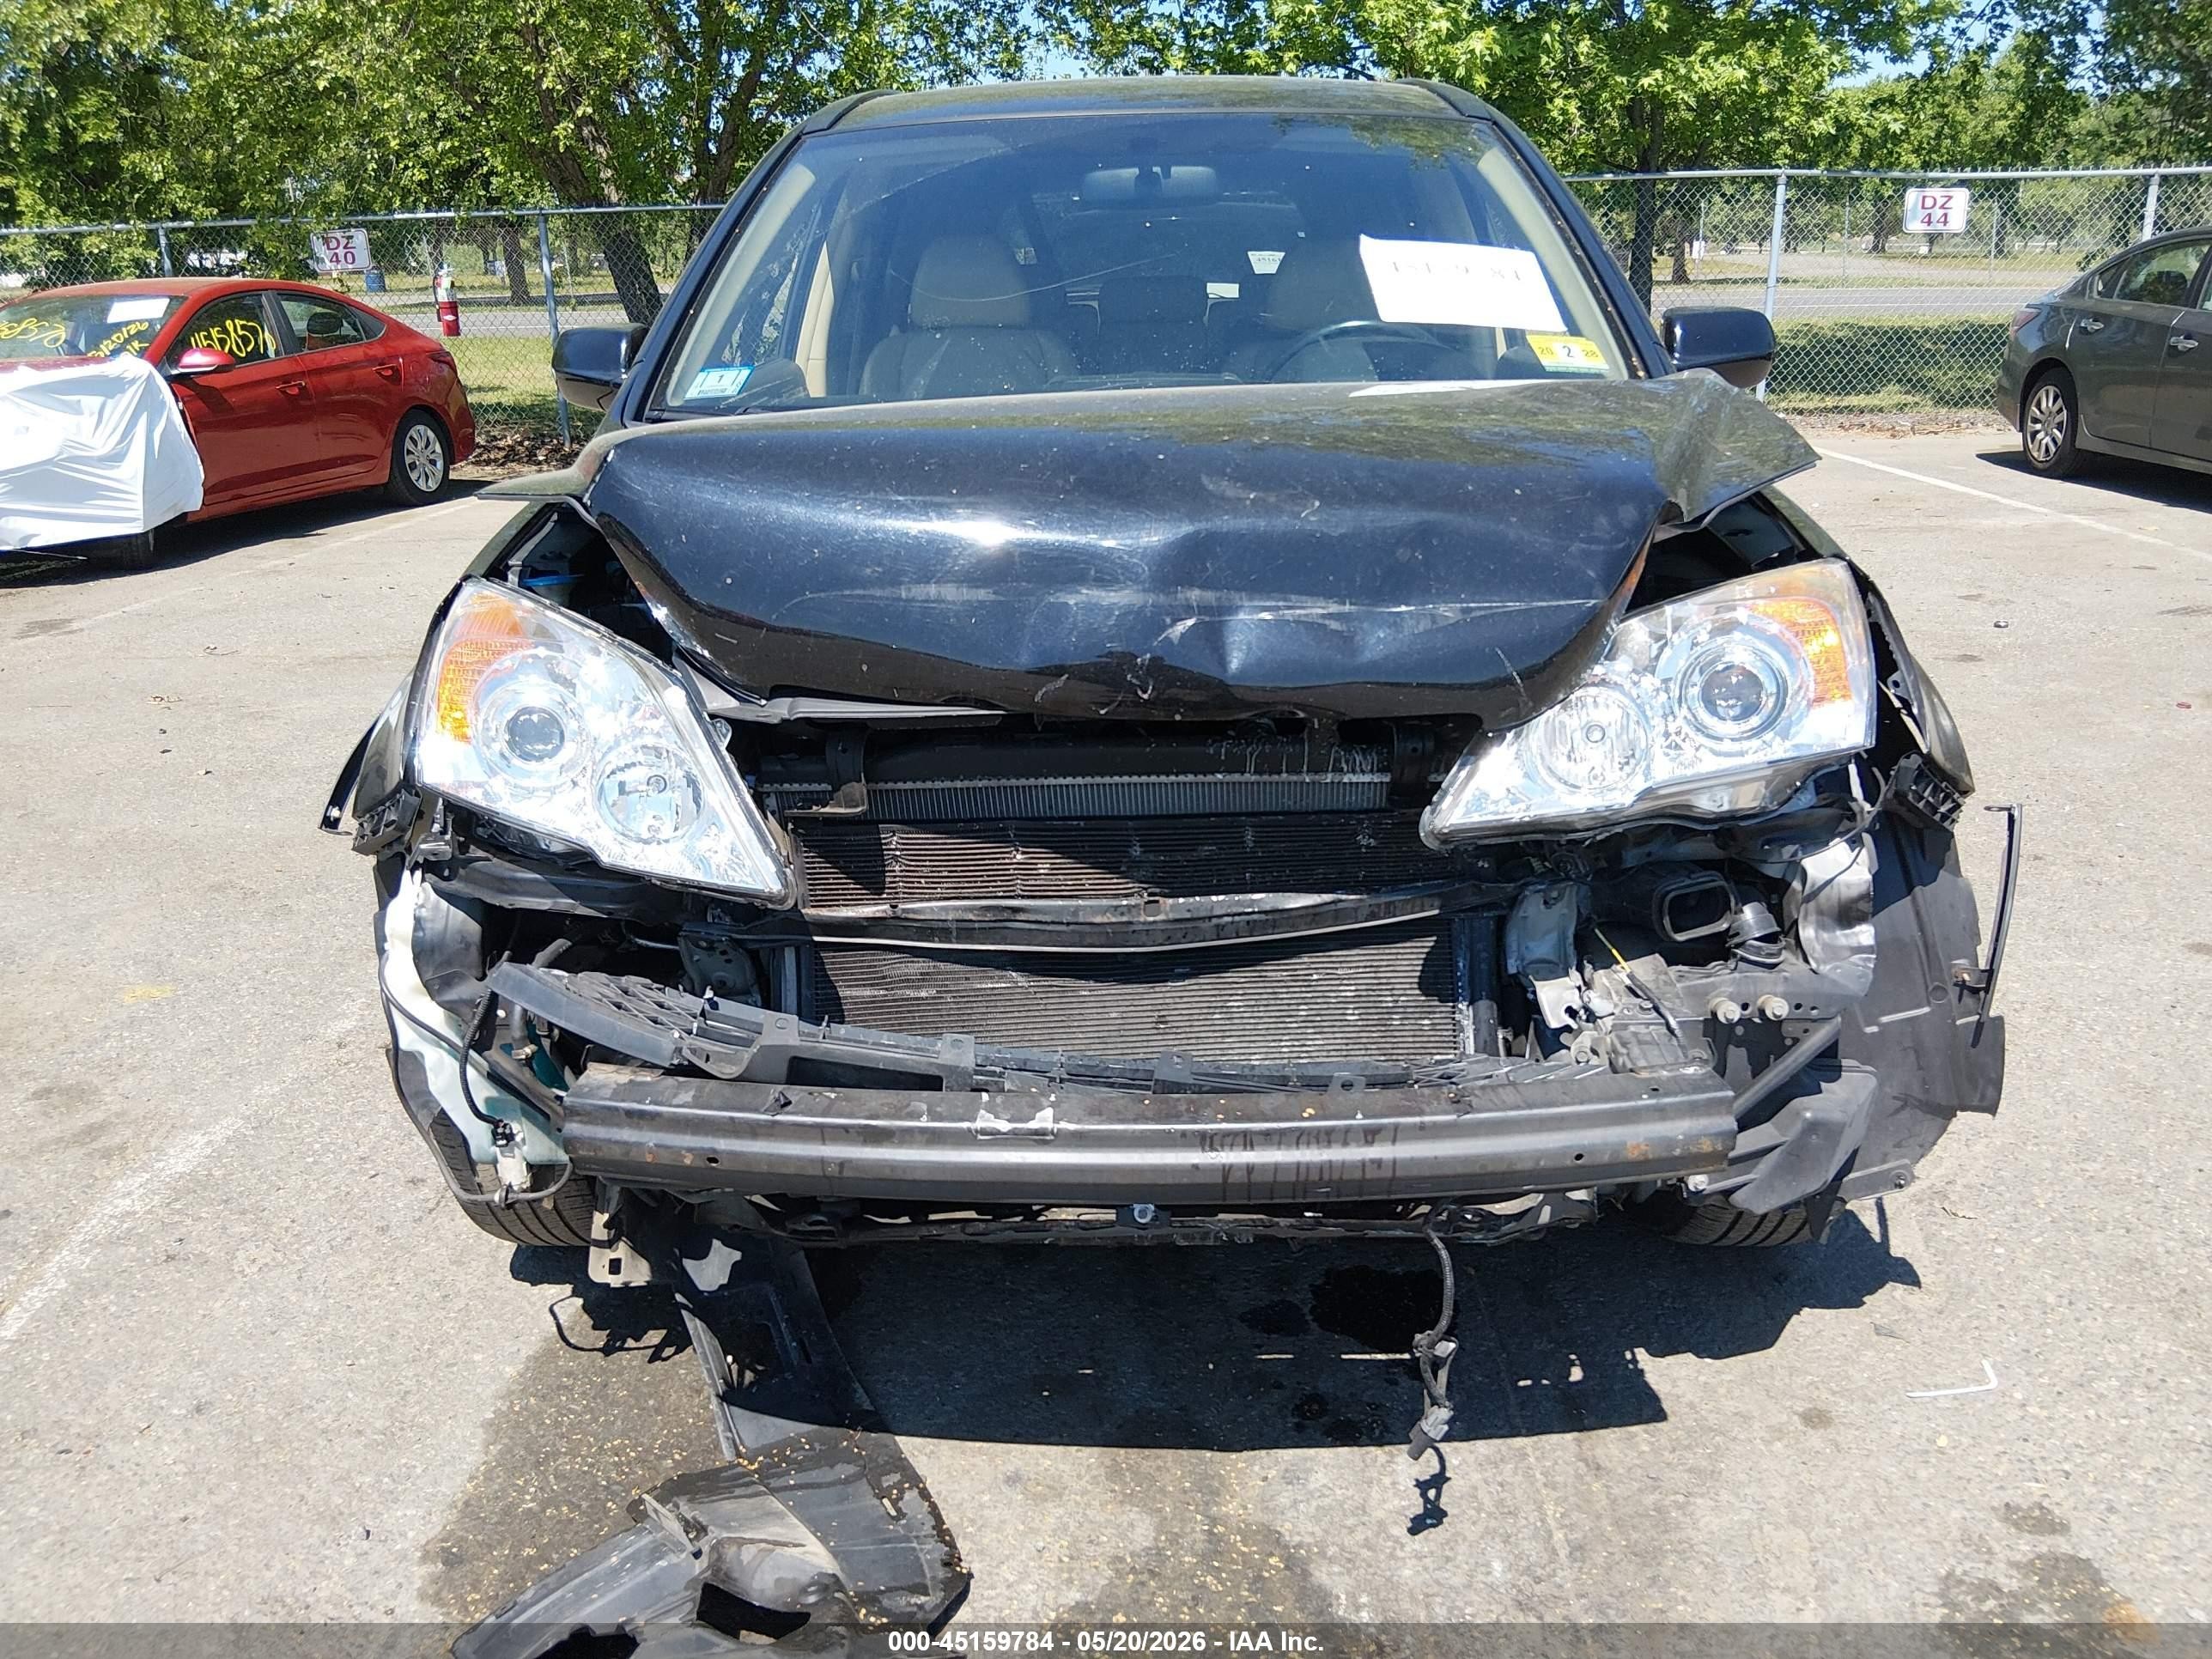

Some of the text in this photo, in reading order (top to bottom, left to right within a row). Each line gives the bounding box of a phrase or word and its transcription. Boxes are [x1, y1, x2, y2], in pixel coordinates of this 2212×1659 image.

[1921, 195, 1954, 210] DZ
[1920, 212, 1949, 227] 44
[325, 235, 356, 251] DZ
[329, 252, 356, 265] 40
[1562, 345, 1574, 358] 2
